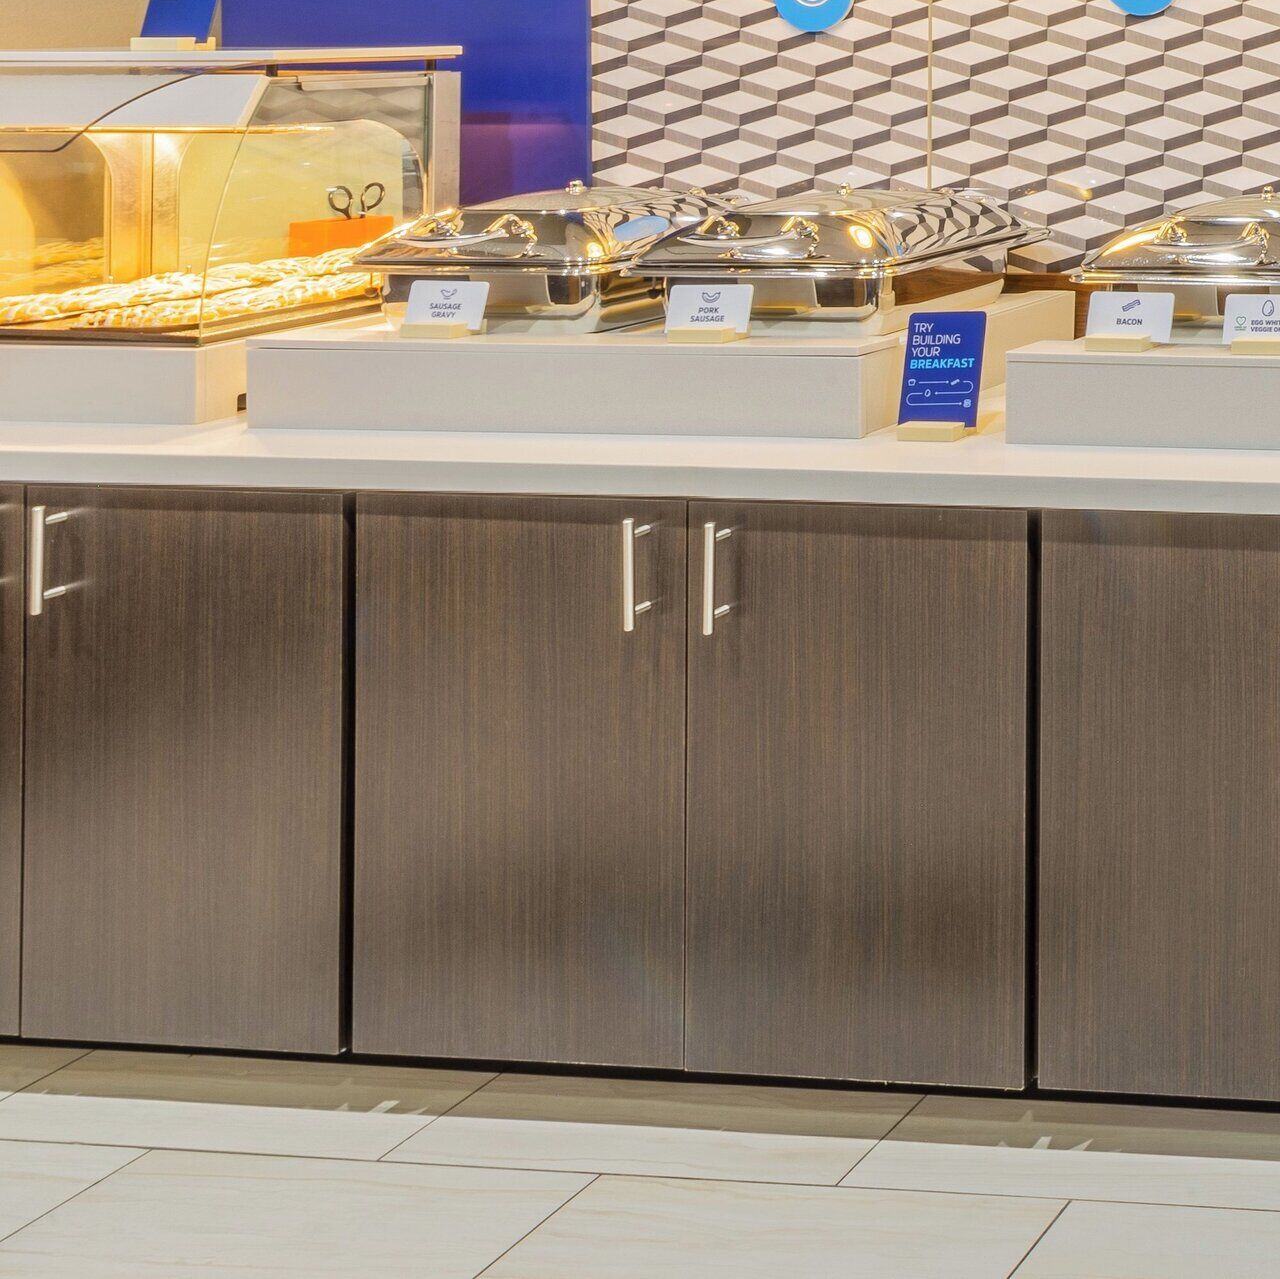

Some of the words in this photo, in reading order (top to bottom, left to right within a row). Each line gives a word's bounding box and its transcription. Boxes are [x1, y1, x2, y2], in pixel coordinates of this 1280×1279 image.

[429, 302, 462, 310] SAUSAGE
[914, 323, 934, 333] TRY
[912, 334, 961, 346] BUILDING
[912, 347, 940, 357] YOUR
[910, 358, 975, 369] BREAKFAST
